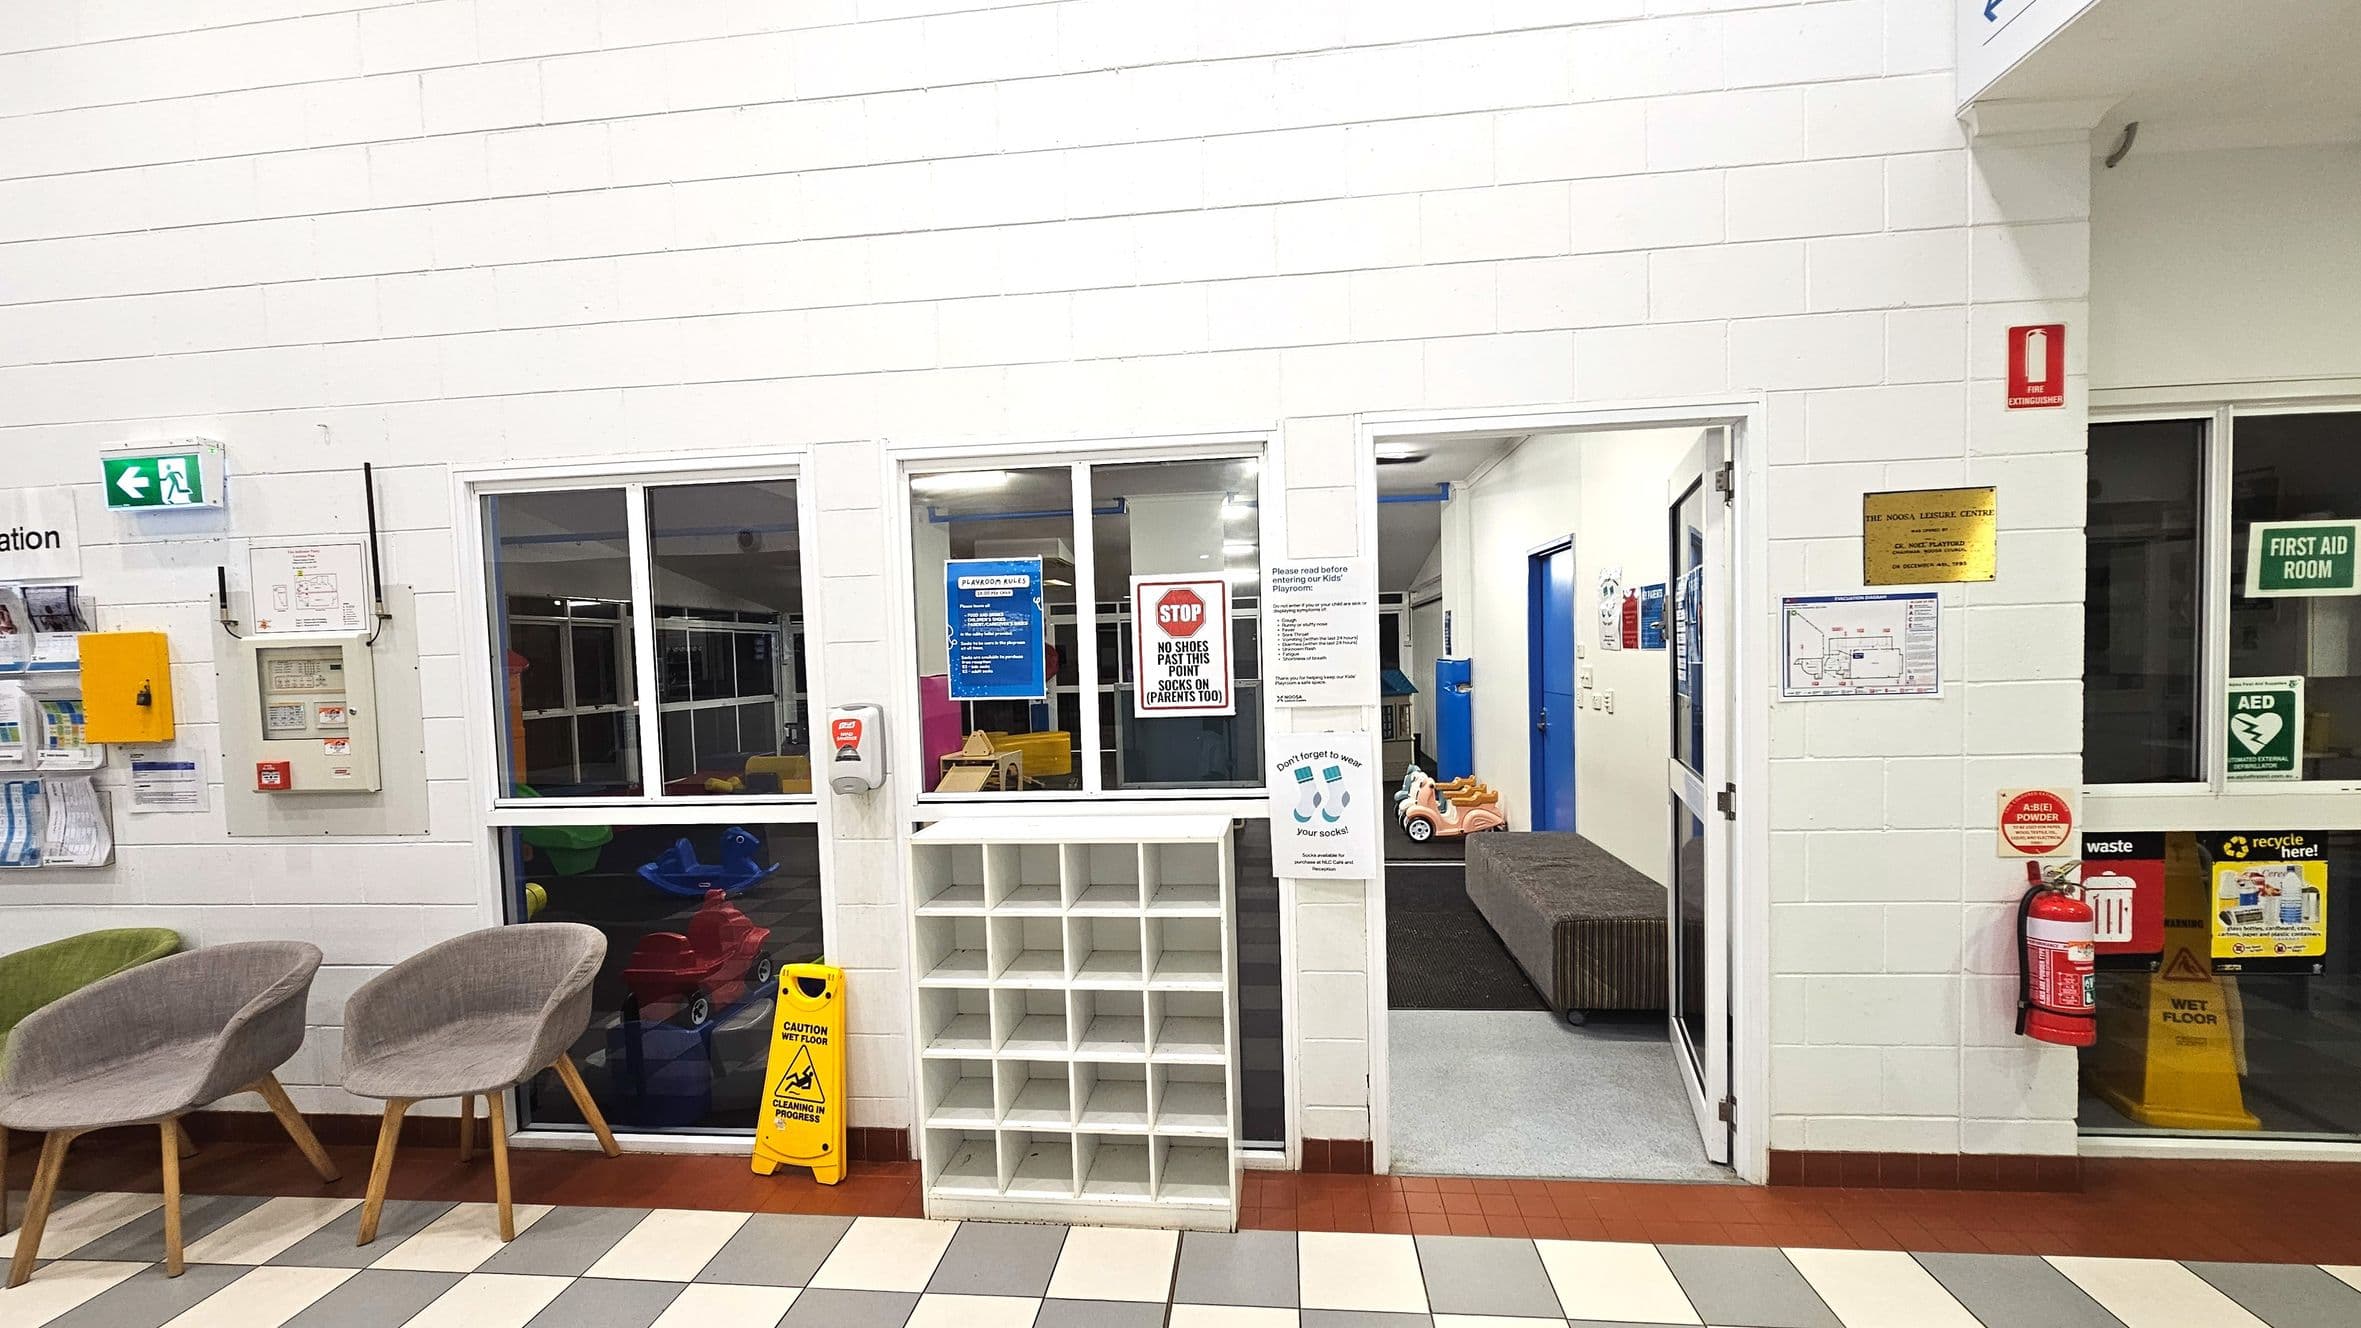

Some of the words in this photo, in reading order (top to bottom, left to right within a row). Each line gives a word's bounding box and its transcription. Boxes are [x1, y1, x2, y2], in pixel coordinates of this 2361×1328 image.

[2008, 396, 2064, 406] EXTINGUISHER
[1920, 510, 1956, 519] LEISURE
[1960, 509, 1994, 518] CENTRE
[0, 526, 60, 552] ation
[2270, 536, 2317, 556] FIRST
[2320, 536, 2348, 555] AID
[2284, 560, 2332, 579] ROOM
[962, 578, 1001, 587] PLAYROOM
[1272, 576, 1306, 584] entering
[1272, 585, 1313, 593] Playroom:
[1160, 604, 1202, 622] STOP
[1158, 642, 1172, 653] NO
[1175, 640, 1209, 653] SHOES
[1158, 653, 1185, 665] PAST
[1186, 653, 1210, 664] THIS
[1169, 665, 1200, 677] POINT
[1158, 680, 1192, 691] SOCKS
[1195, 679, 1209, 690] ON
[1146, 691, 1196, 705] (PARENTS
[1198, 690, 1222, 703] TOO)
[2238, 694, 2275, 710] AED
[1276, 755, 1300, 772] Don't
[1300, 750, 1327, 760] forget
[1330, 751, 1339, 759] to
[1340, 754, 1362, 768] wear
[2016, 814, 2059, 822] POWDER
[1296, 828, 1318, 837] your
[1320, 826, 1349, 837] socks!
[2086, 839, 2133, 854] waste
[2253, 833, 2304, 849] recycle
[2281, 844, 2318, 859] here!
[2170, 998, 2208, 1012] WET
[2163, 1012, 2217, 1025] FLOOR
[784, 1021, 828, 1036] CAUTION
[782, 1032, 799, 1041] WET
[801, 1035, 828, 1045] FLOOR
[773, 1099, 814, 1113] CLEANING
[816, 1105, 825, 1114] IN
[776, 1109, 820, 1123] PROGRESS
